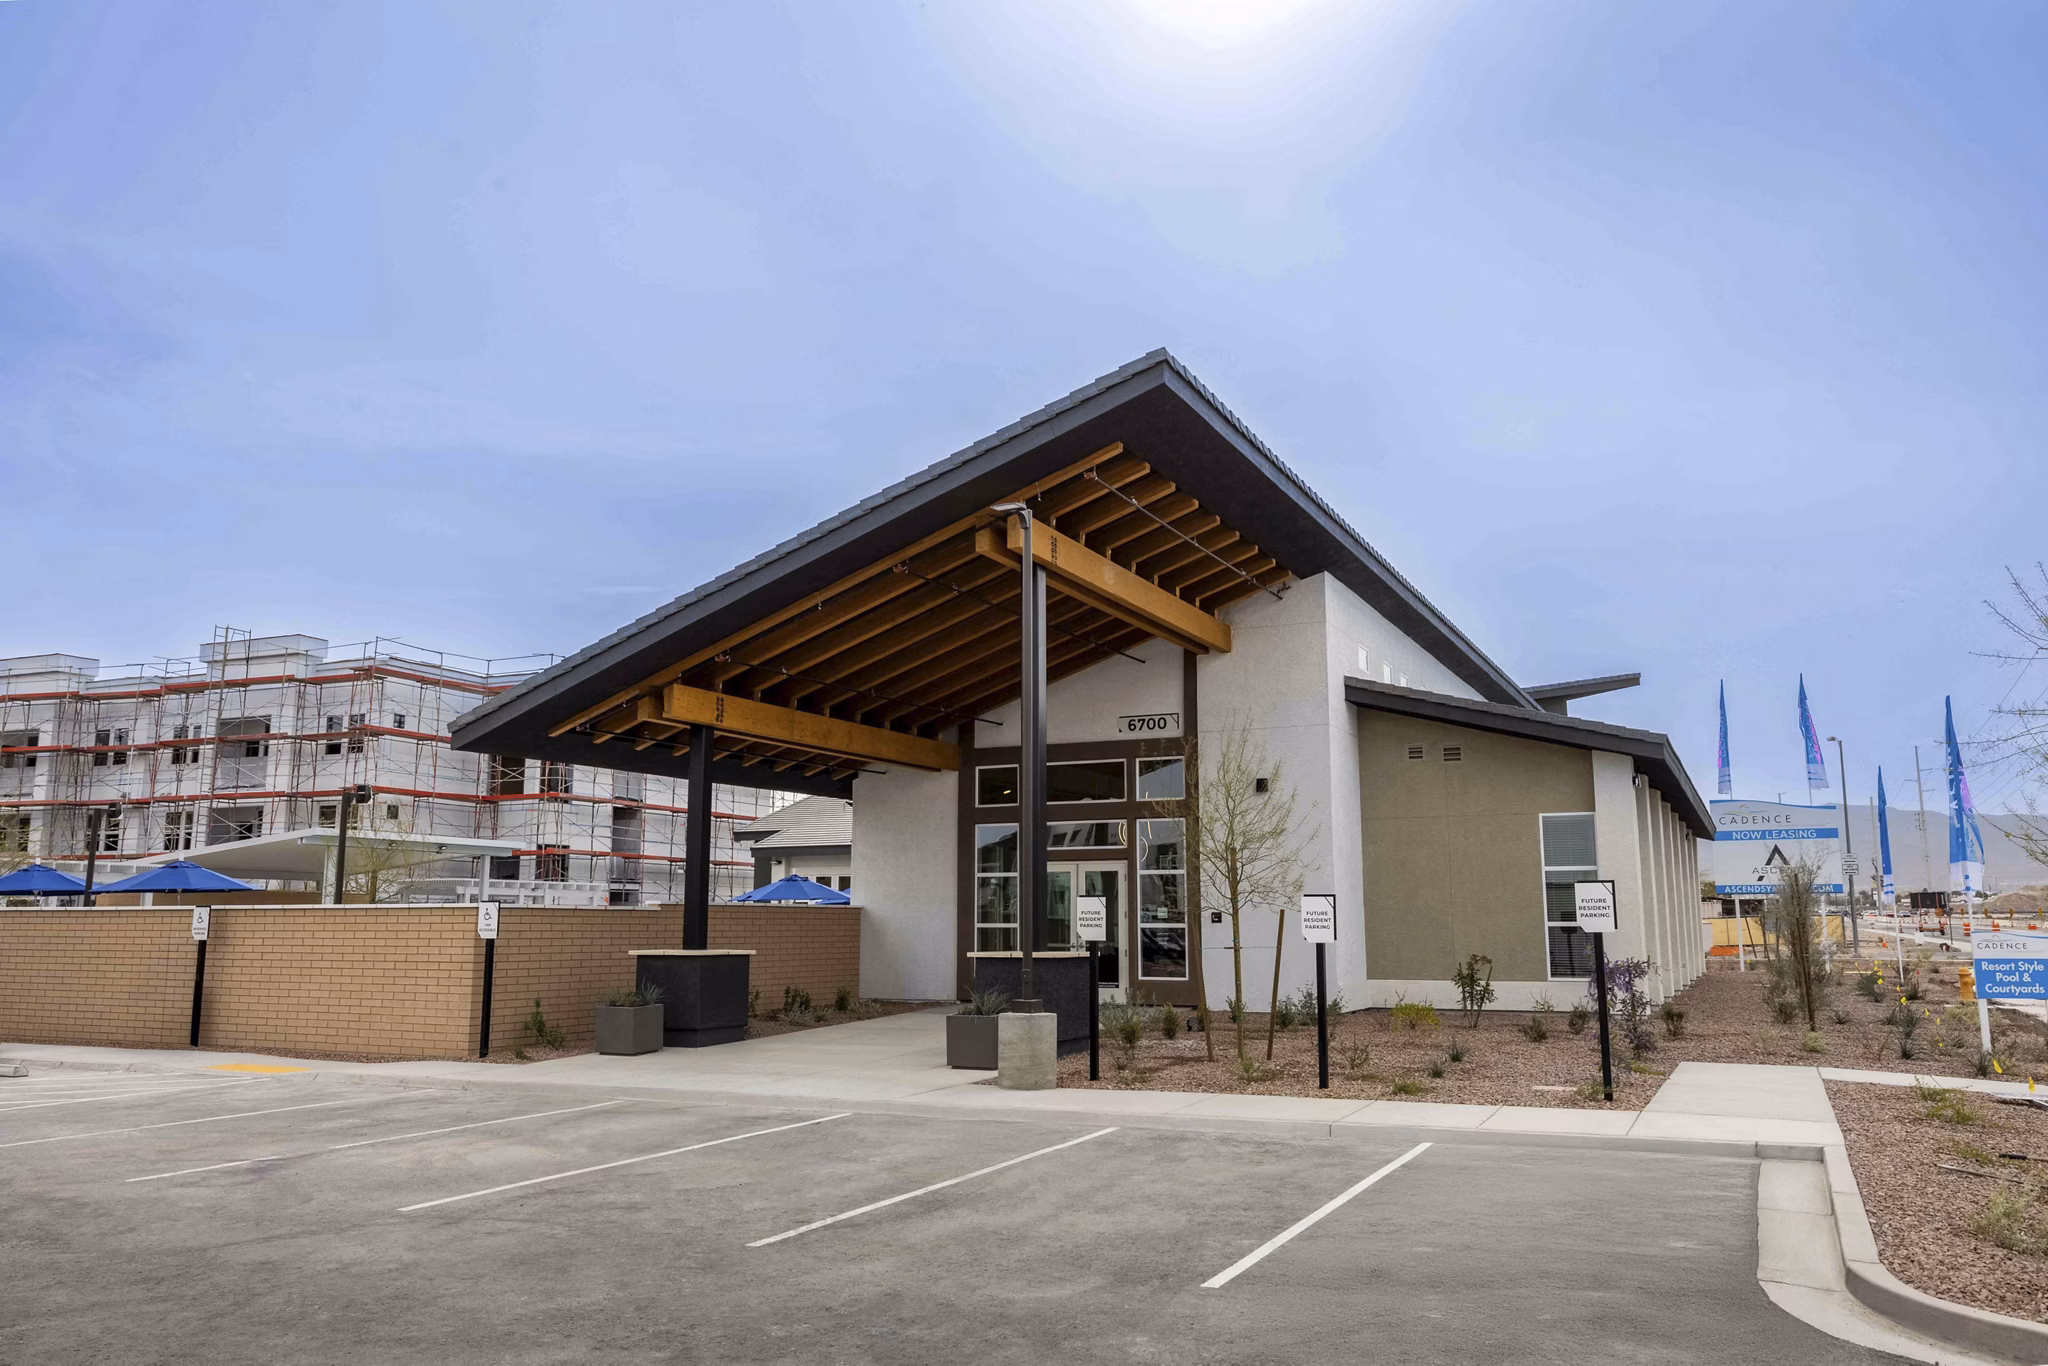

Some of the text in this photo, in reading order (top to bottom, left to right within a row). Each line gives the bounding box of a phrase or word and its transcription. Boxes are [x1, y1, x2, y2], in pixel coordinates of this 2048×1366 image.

[1128, 717, 1167, 731] 6700
[1719, 815, 1791, 825] CADENCE
[1732, 829, 1817, 840] NOW LEASING
[1981, 961, 2044, 973] Resort Style
[1996, 972, 2032, 982] Pool &
[1985, 983, 2045, 996] Courtyards
